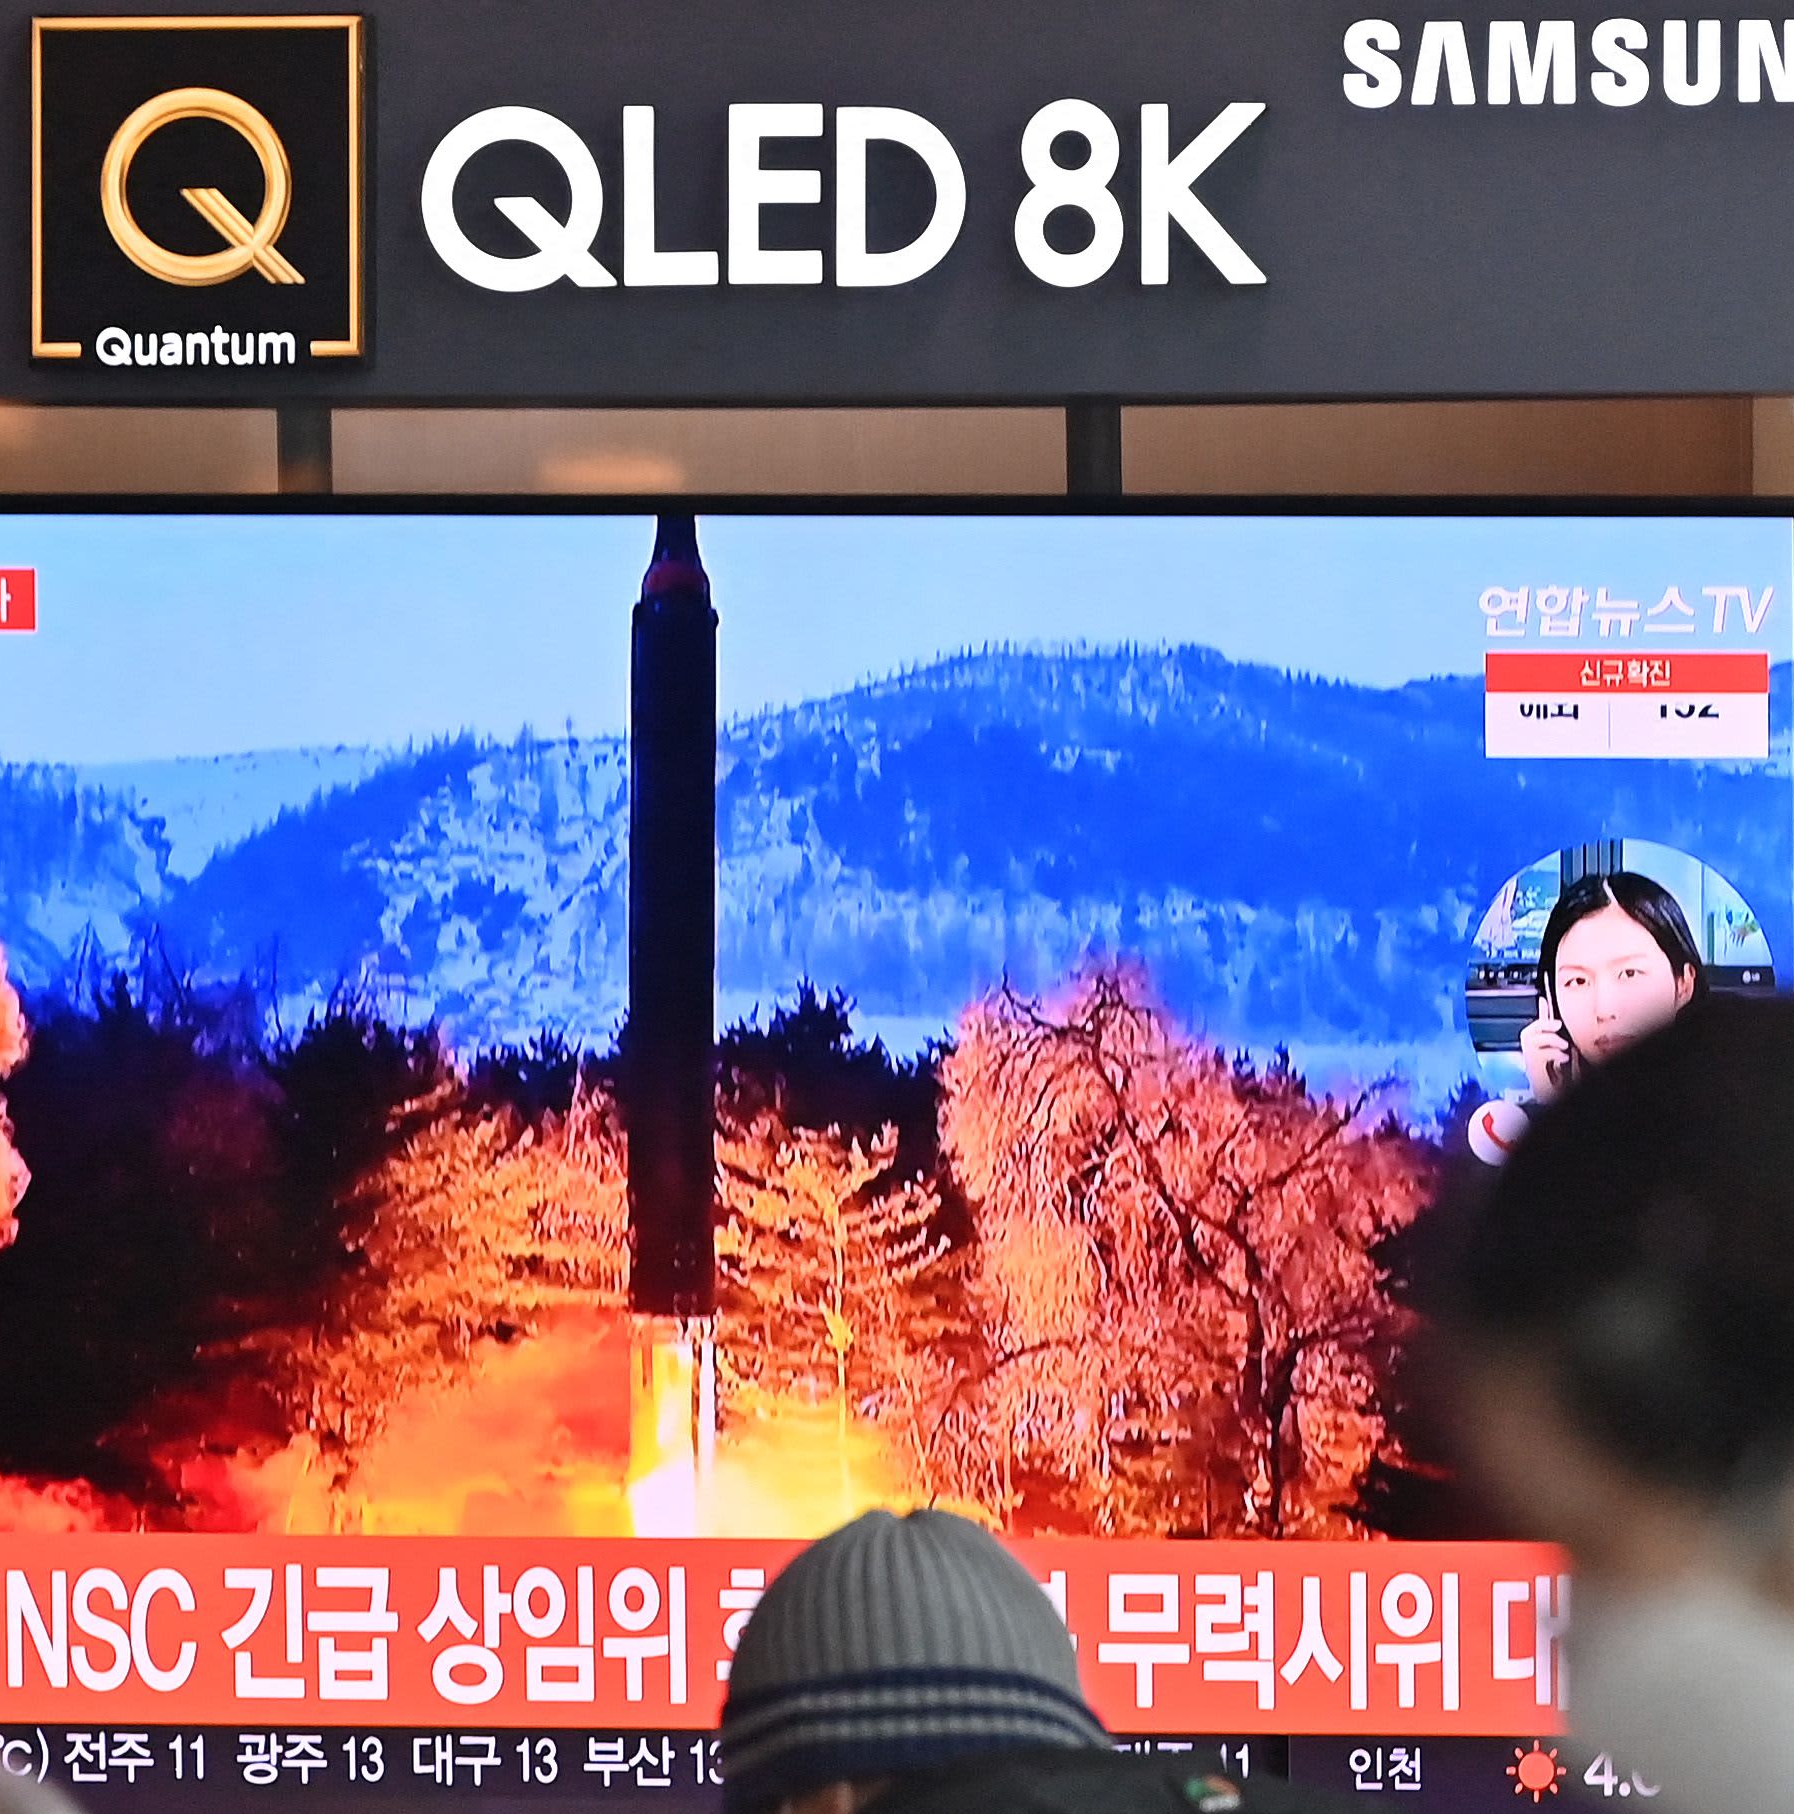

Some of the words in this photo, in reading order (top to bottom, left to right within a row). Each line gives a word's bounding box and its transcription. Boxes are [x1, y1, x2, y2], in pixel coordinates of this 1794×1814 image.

[100, 87, 306, 287] Q
[420, 103, 968, 293] QLED
[1013, 98, 1268, 288] 8K
[95, 324, 297, 366] Quantum
[1579, 658, 1672, 689] 신규확진
[6, 1567, 198, 1692] NSC
[221, 1563, 400, 1702] 긴급
[417, 1565, 688, 1706] 상임위
[1098, 1571, 1460, 1711] 무력시위
[63, 1731, 156, 1783] 전주
[168, 1734, 205, 1780] 11
[236, 1732, 328, 1785] 광주
[342, 1735, 385, 1783] 13
[412, 1733, 503, 1787] 대구
[515, 1737, 559, 1784] 13
[583, 1735, 676, 1787] 부산
[1348, 1747, 1423, 1791] 인천
